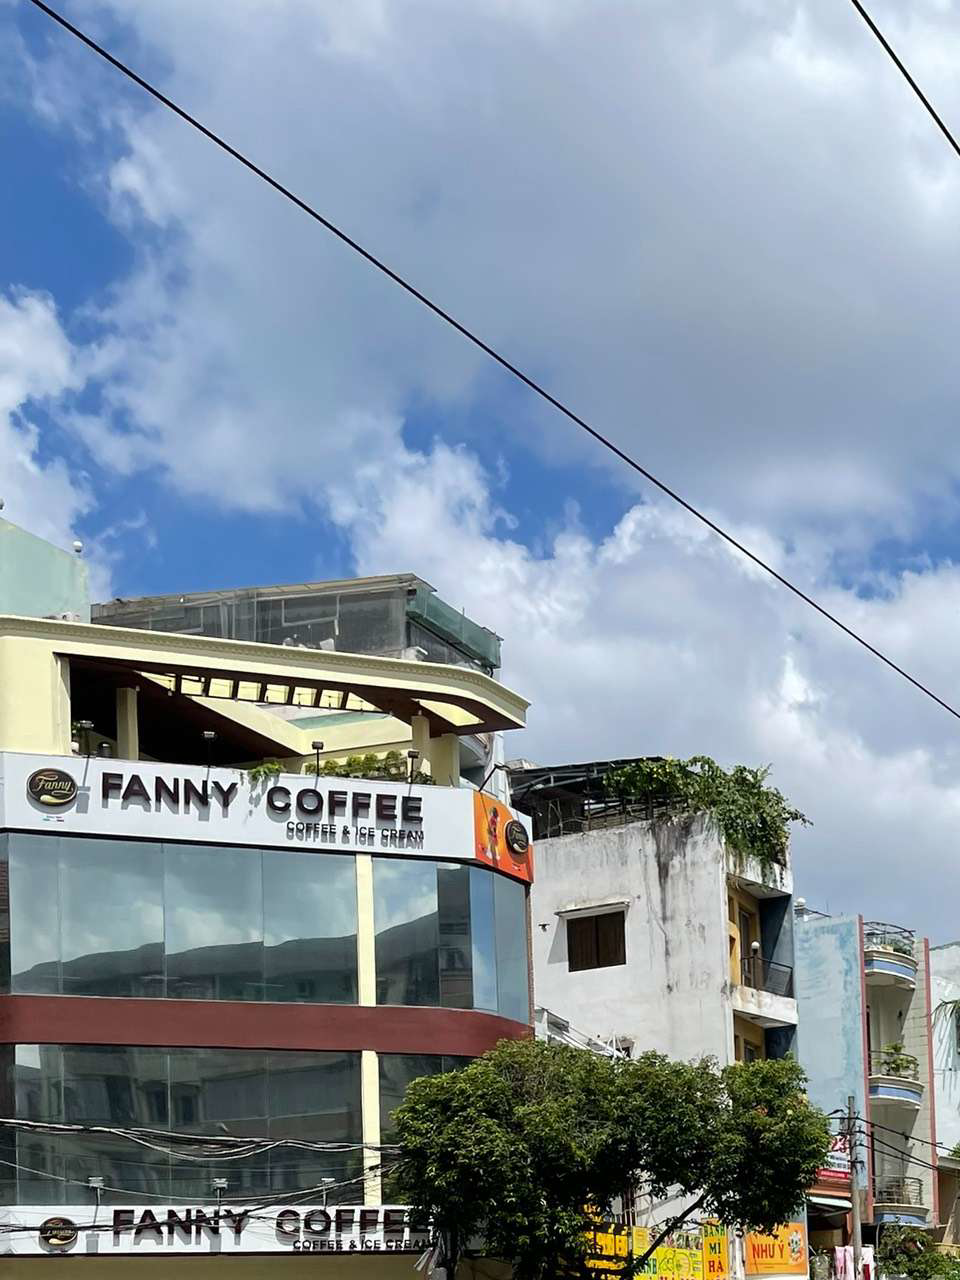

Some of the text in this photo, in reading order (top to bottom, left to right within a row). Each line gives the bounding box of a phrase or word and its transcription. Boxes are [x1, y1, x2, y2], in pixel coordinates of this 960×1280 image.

[35, 775, 74, 794] Fanny
[101, 771, 238, 809] FANNY
[266, 785, 424, 824] COFFEE
[286, 821, 425, 840] COFFEE & ICE CREAM
[112, 1208, 249, 1235] FANNY
[293, 1239, 343, 1250] COFFEE
[349, 1239, 357, 1249] &
[361, 1239, 381, 1249] ICE
[709, 1238, 721, 1255] MÌ
[708, 1256, 724, 1273] HÀ
